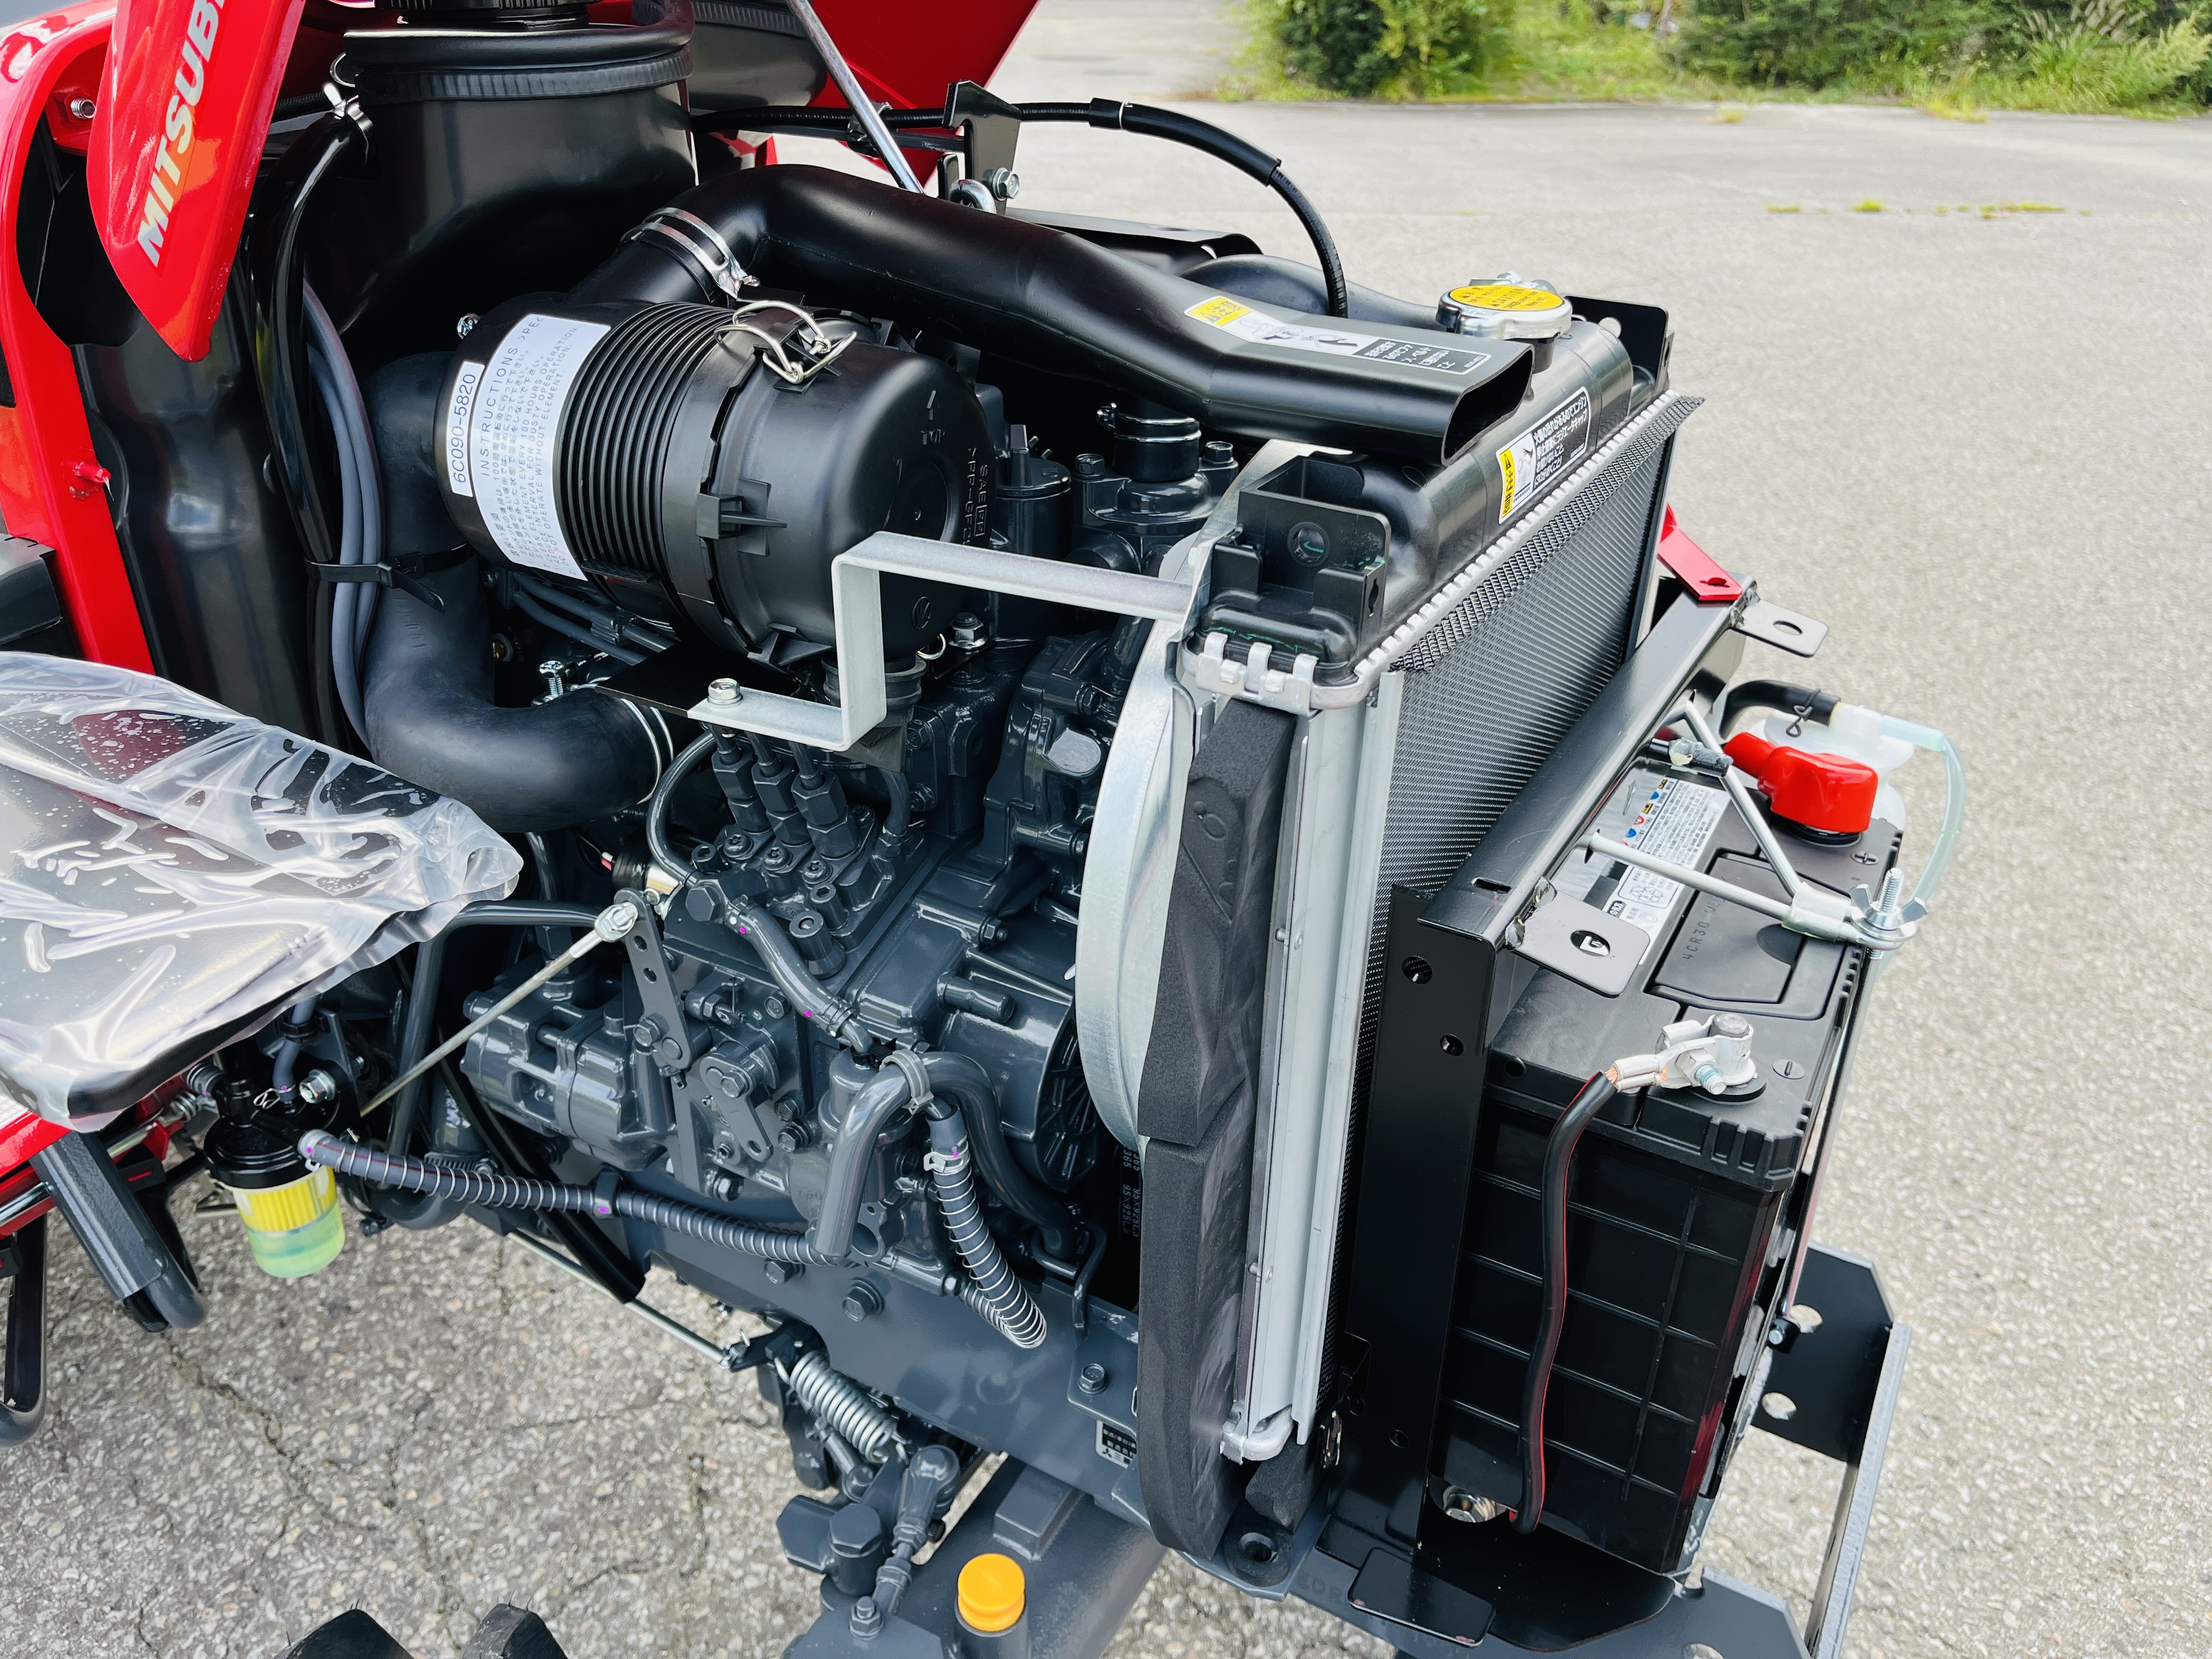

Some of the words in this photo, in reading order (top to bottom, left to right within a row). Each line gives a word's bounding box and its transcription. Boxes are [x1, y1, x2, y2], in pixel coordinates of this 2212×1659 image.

[137, 0, 224, 267] MITSUB
[480, 348, 518, 476] INSTRUCTIONS
[526, 379, 542, 414] HOURS
[451, 373, 477, 484] 6C090-5820
[521, 420, 529, 438] 100
[529, 406, 541, 441] DUSTY
[918, 428, 945, 445] TOP
[535, 426, 545, 476] WITHOUT
[520, 486, 537, 531] ELEMENT
[527, 476, 544, 527] INTERVAL
[535, 481, 551, 529] OPERATE
[533, 536, 553, 562] CLEAN
[539, 531, 561, 565] REDUCE
[548, 534, 564, 551] NOT
[558, 555, 570, 567] DO
